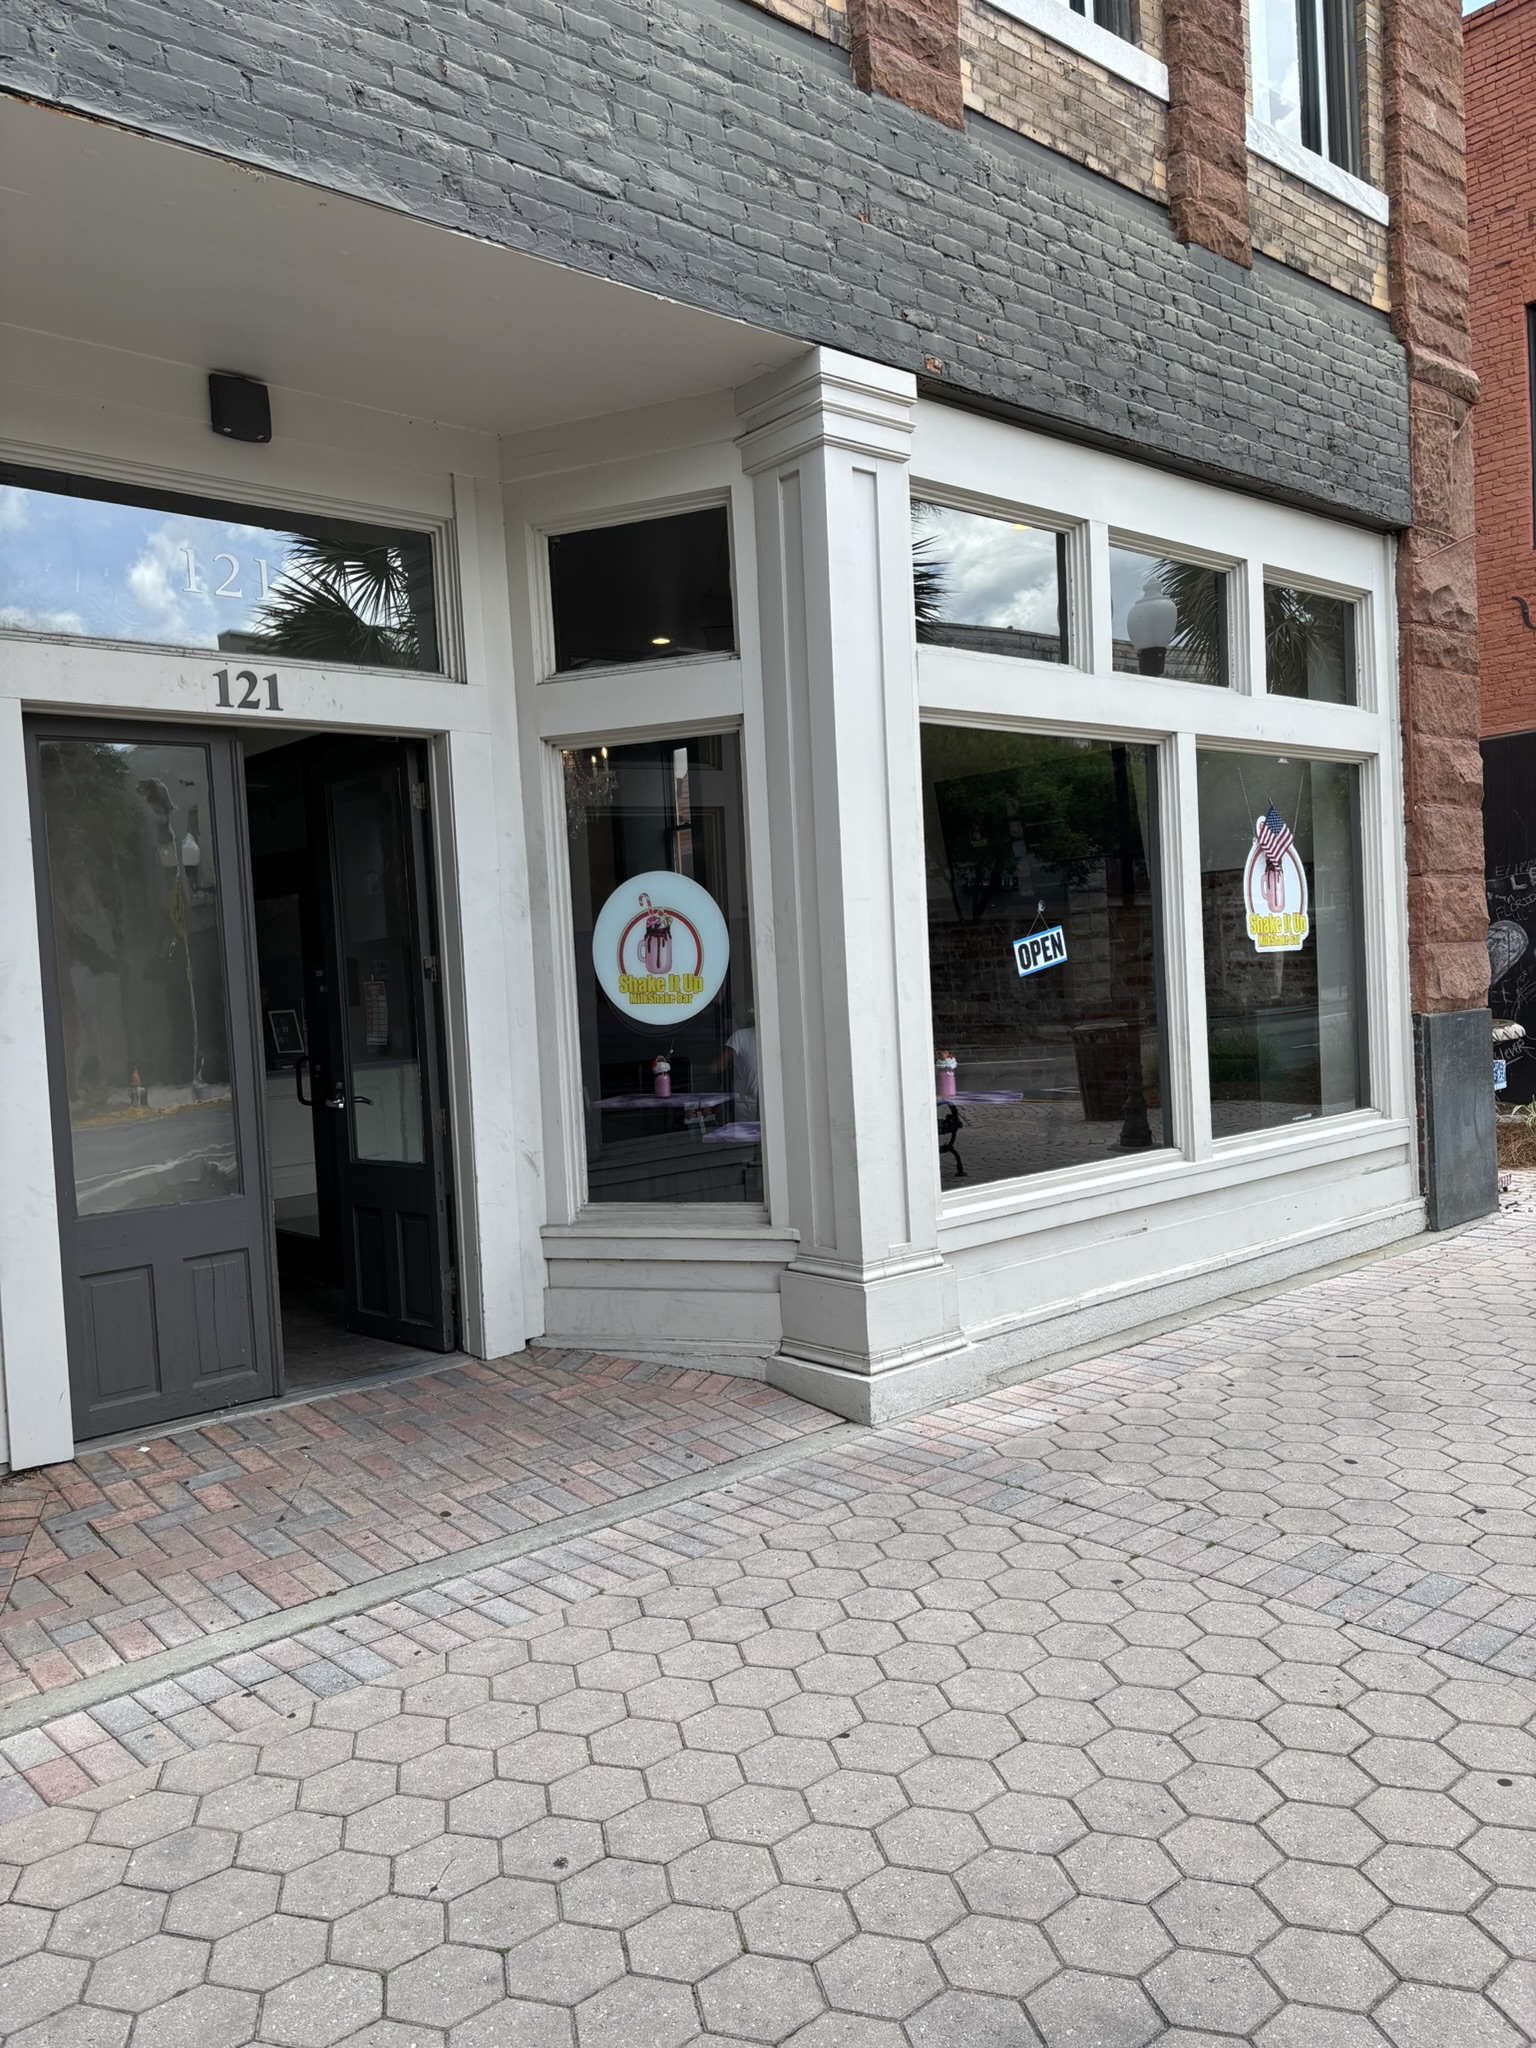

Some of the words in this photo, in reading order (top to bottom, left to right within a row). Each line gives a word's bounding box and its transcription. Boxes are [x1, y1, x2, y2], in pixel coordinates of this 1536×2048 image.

[180, 547, 271, 601] 121
[212, 668, 284, 712] 121
[1249, 913, 1283, 935] Shake
[1283, 912, 1291, 933] It
[1292, 911, 1306, 935] Up
[1017, 931, 1065, 971] OPEN
[618, 974, 666, 994] Shake
[668, 973, 681, 993] It
[682, 973, 704, 994] Up
[676, 992, 694, 1005] Bar
